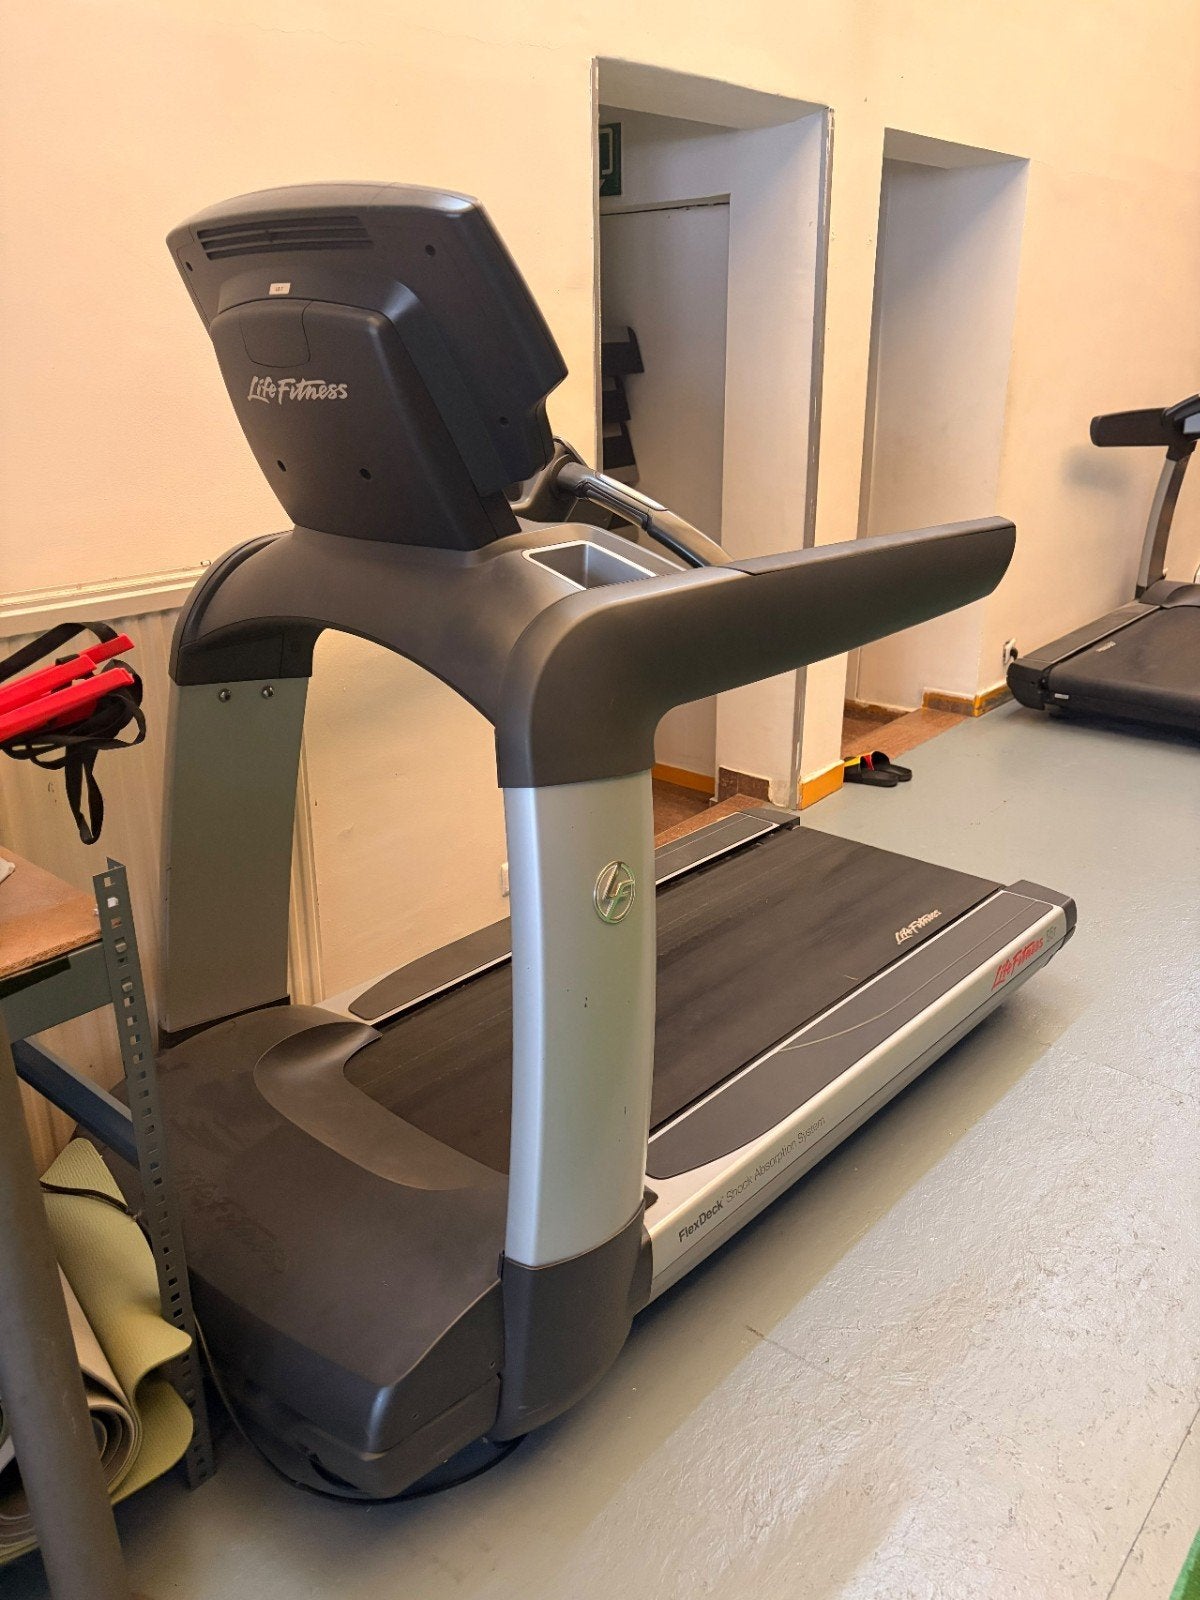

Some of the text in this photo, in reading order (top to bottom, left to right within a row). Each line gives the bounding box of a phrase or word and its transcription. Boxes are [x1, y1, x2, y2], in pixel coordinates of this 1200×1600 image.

[678, 1116, 826, 1243] FlexDeck Shock Absorption System
